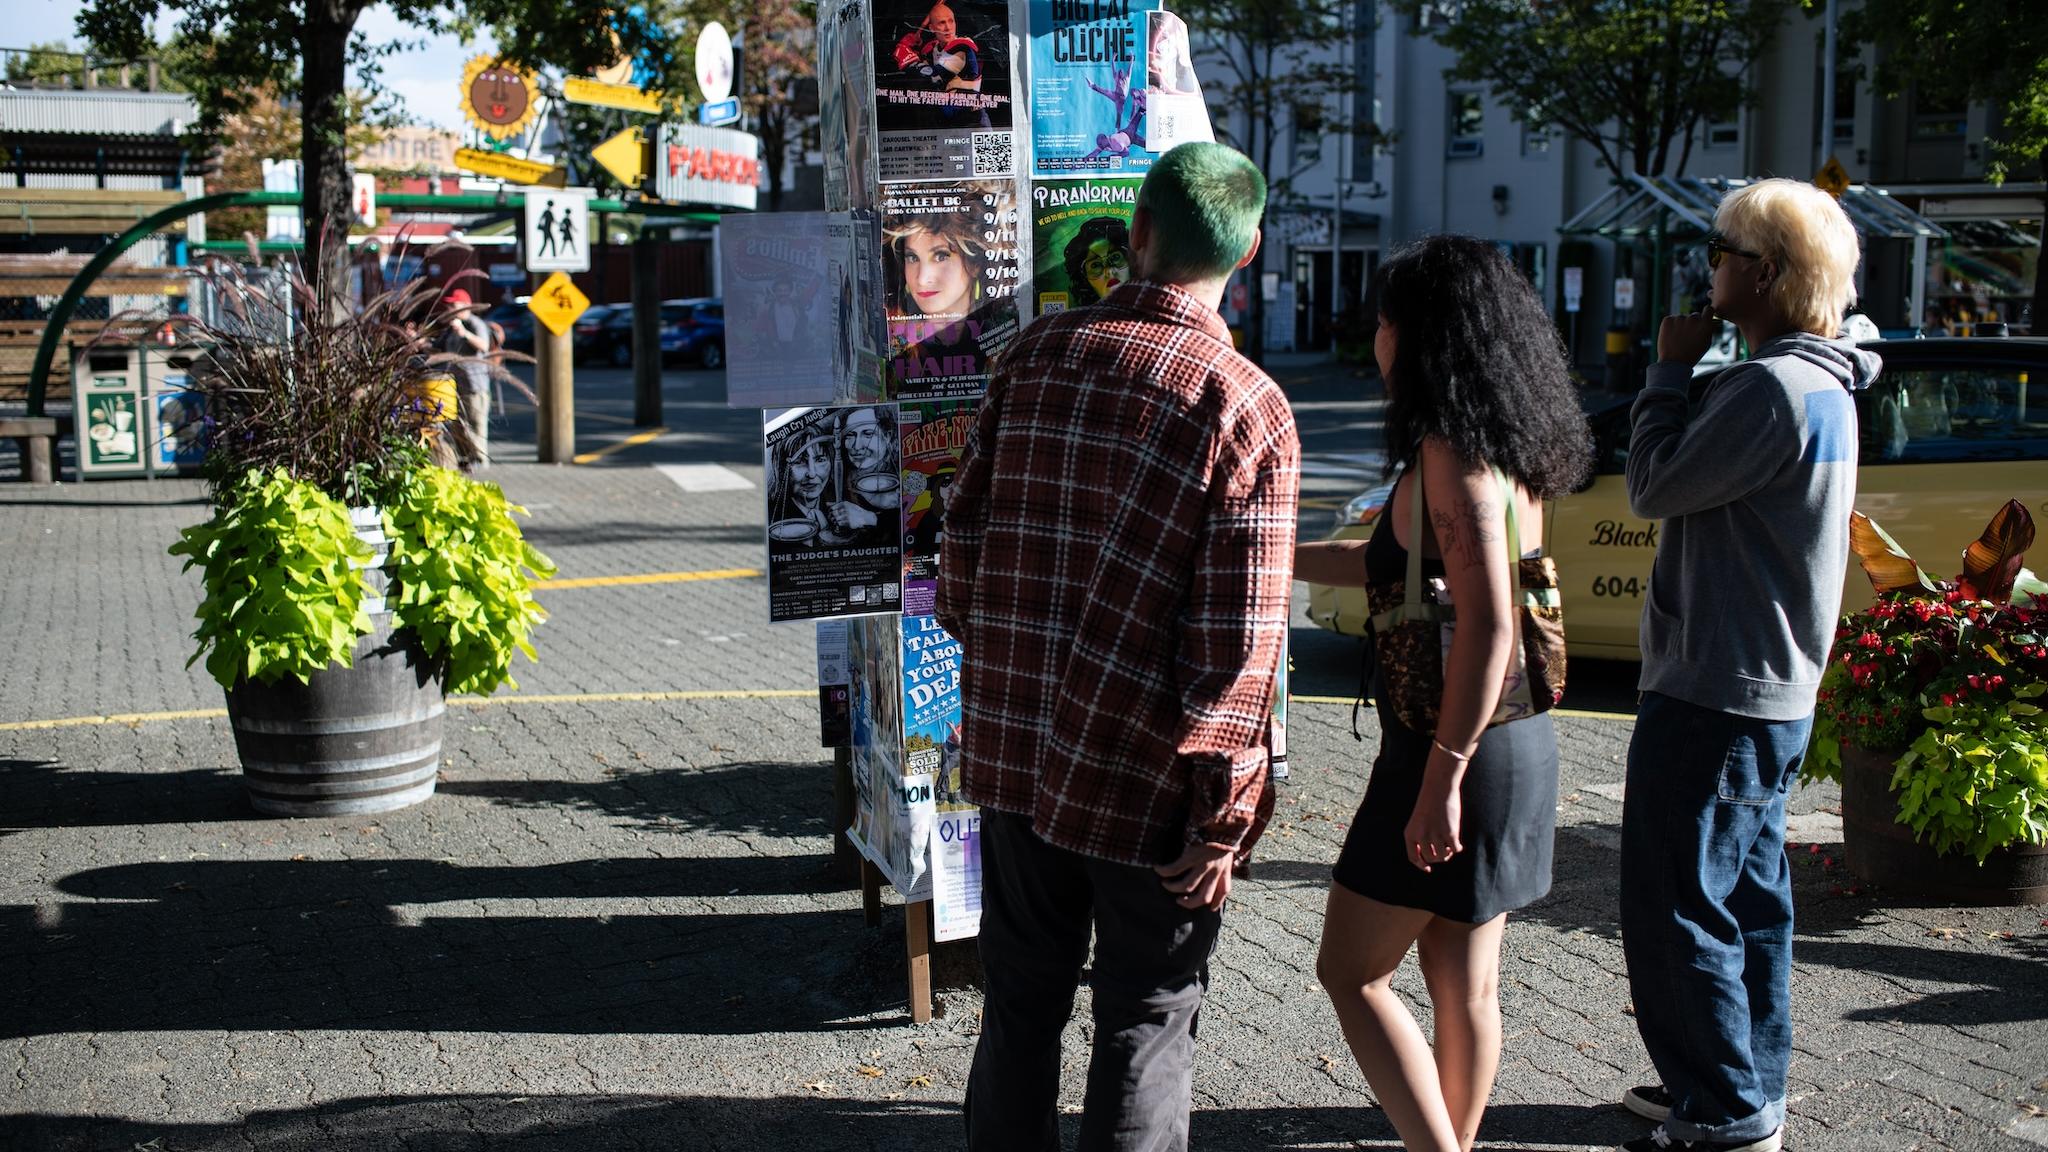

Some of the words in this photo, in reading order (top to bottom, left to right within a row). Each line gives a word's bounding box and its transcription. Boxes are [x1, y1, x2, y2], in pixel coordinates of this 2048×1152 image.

[876, 88, 888, 96] ONE
[907, 90, 919, 98] ONE
[898, 96, 908, 104] HIT
[909, 97, 920, 105] THE
[922, 98, 949, 106] FASTEST
[887, 196, 940, 208] BALLET
[943, 196, 962, 206] BC
[1033, 181, 1137, 209] PARANORMA
[887, 208, 904, 216] 1286
[905, 206, 958, 214] CARTWRIGHT
[986, 266, 1019, 280] 9/16
[894, 355, 976, 378] HAIR
[905, 376, 941, 384] WRITTEN
[896, 392, 933, 400] DIRECTED
[766, 427, 791, 445] Laugh
[790, 419, 804, 432] Cry
[804, 407, 828, 426] Judge
[1589, 520, 1658, 548] Black
[771, 554, 793, 562] THE
[795, 550, 840, 561] JUDGE'S
[842, 546, 899, 558] DAUGHTER
[1592, 576, 1647, 598] 604-
[920, 643, 964, 664] ABOU
[907, 658, 958, 684] YOUR
[908, 670, 961, 710] DEA
[918, 714, 932, 726] BEST
[909, 756, 939, 768] SOLD
[912, 763, 939, 776] OUT!
